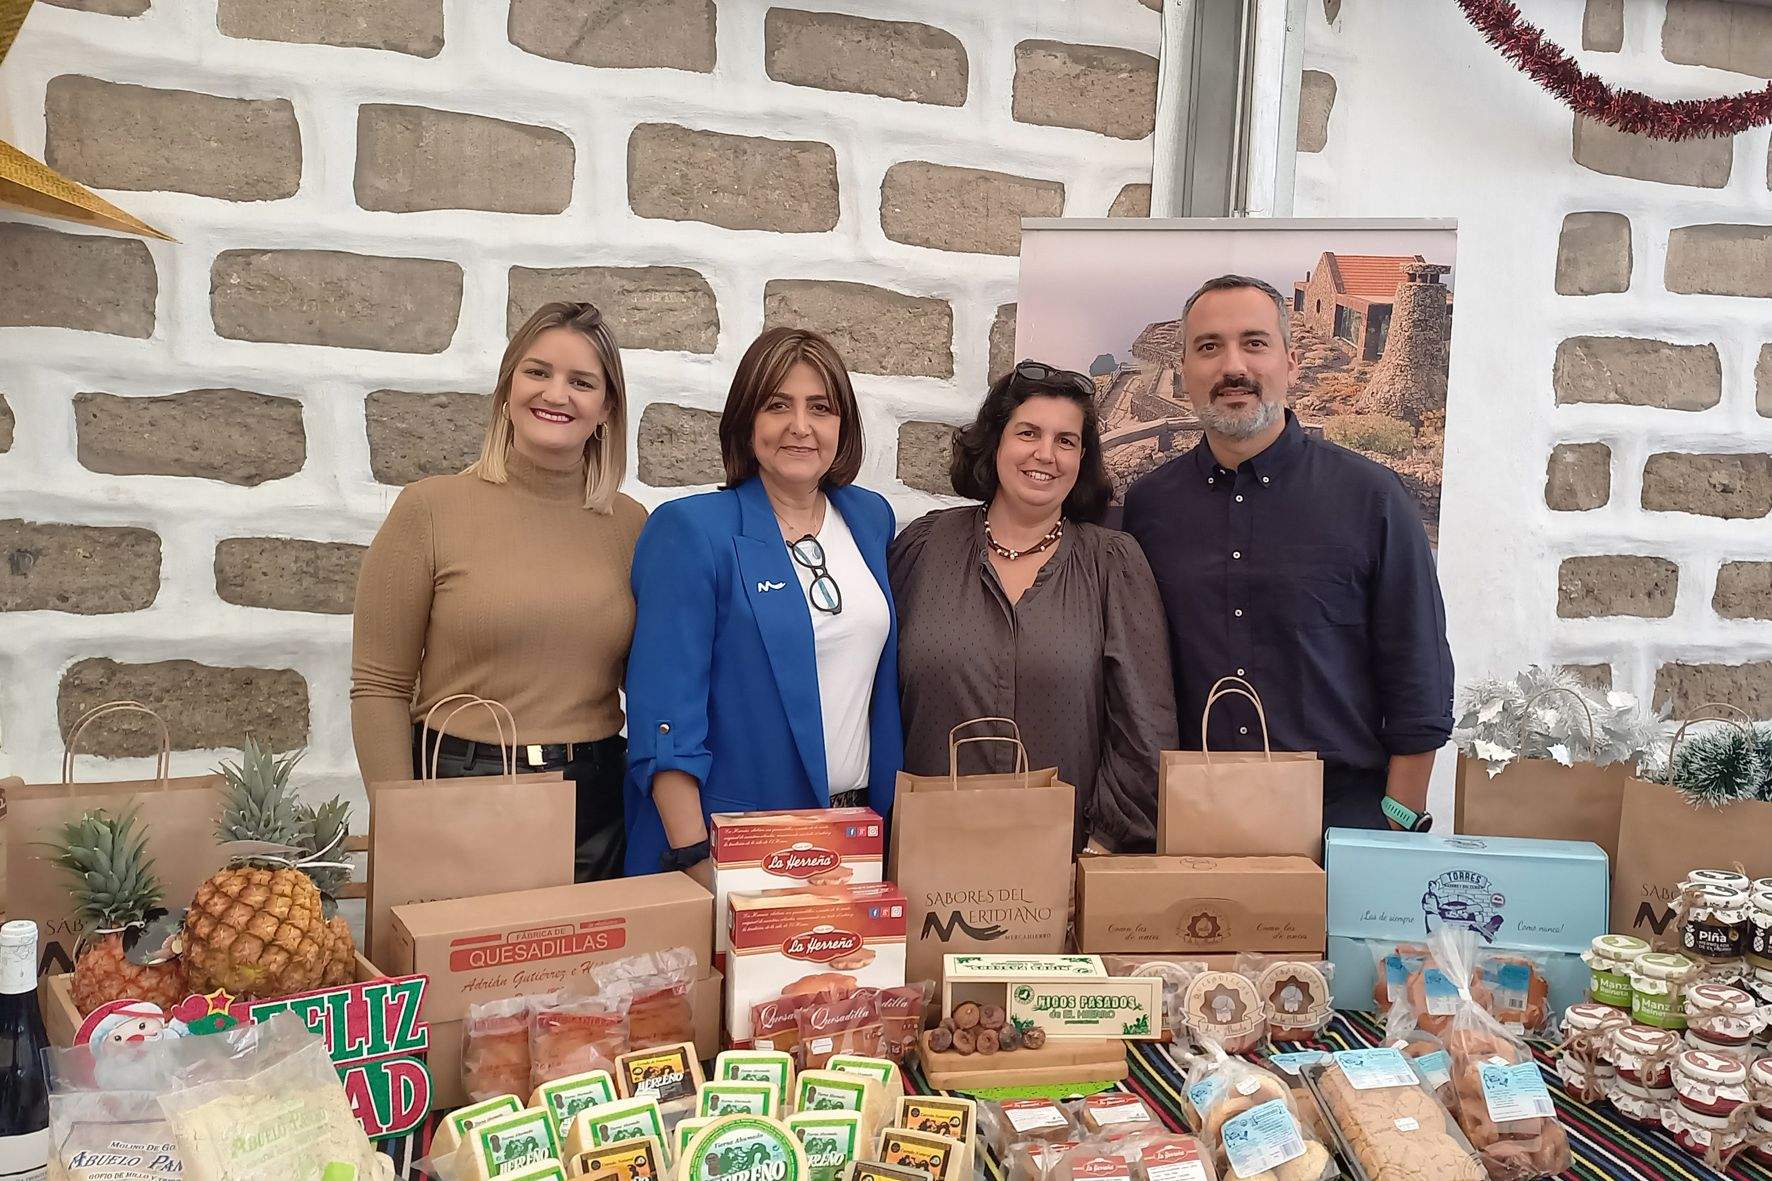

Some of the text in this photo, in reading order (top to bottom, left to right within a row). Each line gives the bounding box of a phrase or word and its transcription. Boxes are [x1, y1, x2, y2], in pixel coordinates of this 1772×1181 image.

[768, 854, 832, 870] La Herreña
[1447, 871, 1482, 883] TORRES
[925, 888, 1033, 908] SABORES DEL
[920, 905, 1052, 943] MERIDIANO
[1699, 930, 1727, 942] Piña
[469, 933, 609, 967] QUESADILLAS
[788, 938, 854, 954] La Herreña
[461, 975, 507, 992] Adrián
[513, 968, 567, 989] Gutiérrez
[1600, 978, 1629, 990] Manz
[1080, 995, 1137, 1010] PASADOS
[811, 1006, 870, 1030] Quesadilla
[68, 1151, 141, 1169] ABUELO
